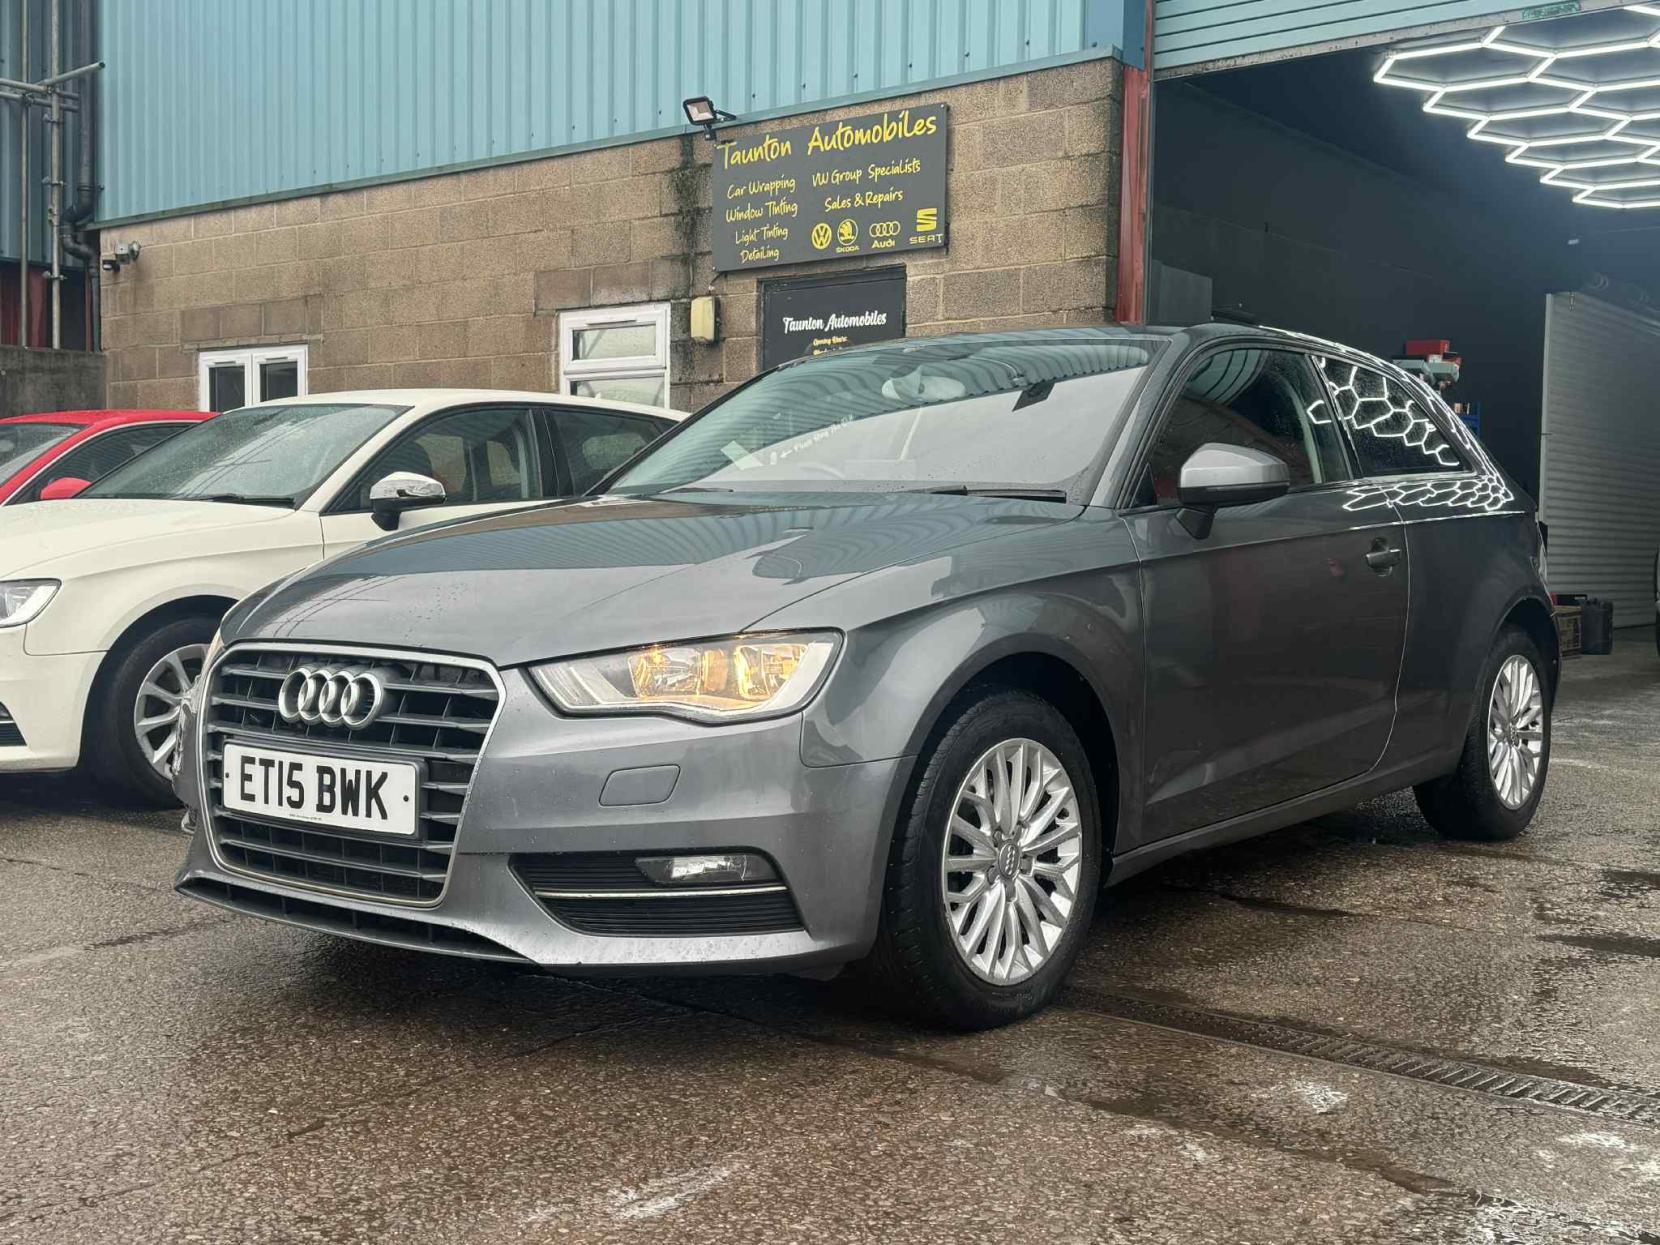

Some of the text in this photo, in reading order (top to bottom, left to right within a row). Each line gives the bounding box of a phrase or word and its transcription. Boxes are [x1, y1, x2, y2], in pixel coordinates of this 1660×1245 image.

[716, 110, 937, 170] Taunton Automobiles
[812, 158, 921, 187] VW Group Specialists
[727, 174, 796, 199] Car Wrapping
[824, 186, 904, 212] Sales & Repairs
[725, 196, 798, 223] Window Tinting
[735, 221, 789, 246] Light Tinting
[871, 239, 896, 249] Audi
[909, 233, 945, 245] SEAT
[740, 244, 780, 264] Detailing
[782, 310, 887, 334] Taunton Automobiles
[240, 754, 389, 821] ET15 BWK
